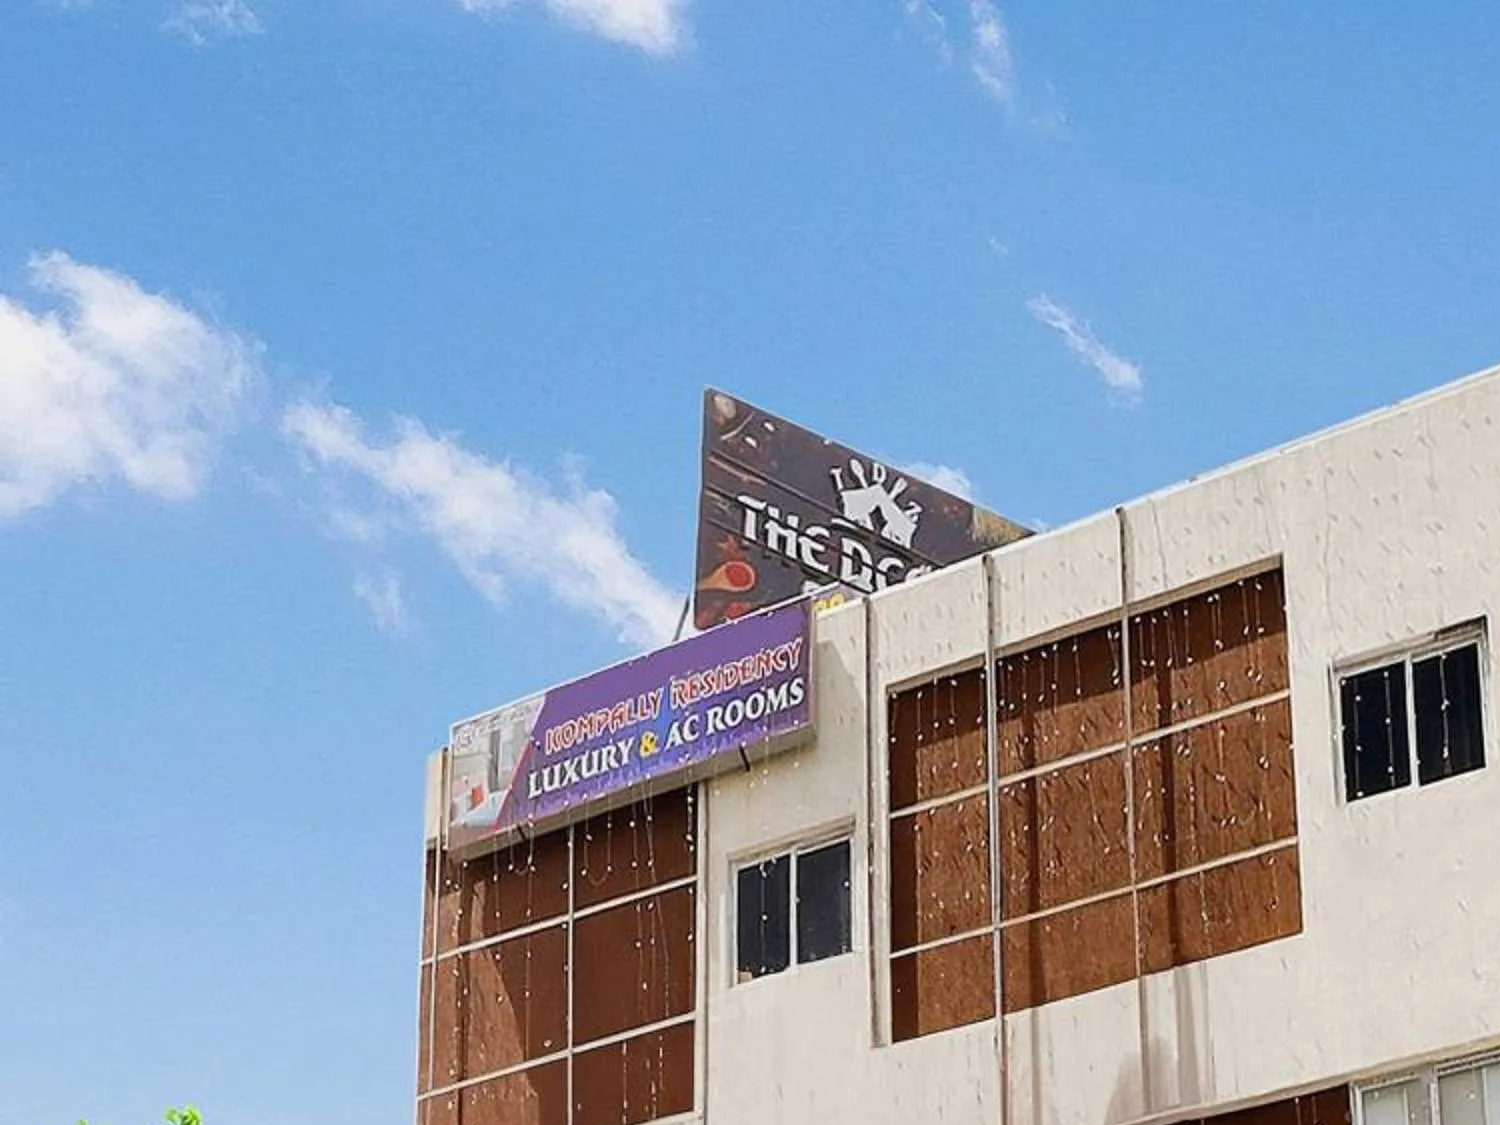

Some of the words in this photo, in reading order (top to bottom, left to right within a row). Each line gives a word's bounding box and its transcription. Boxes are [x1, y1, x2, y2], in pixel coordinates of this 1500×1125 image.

[528, 736, 634, 799] LUXURY
[639, 731, 659, 758] &
[665, 714, 699, 750] AC
[705, 677, 804, 735] ROOMS
[544, 687, 664, 757] KOMPALLY
[670, 637, 803, 709] RESIDENCY
